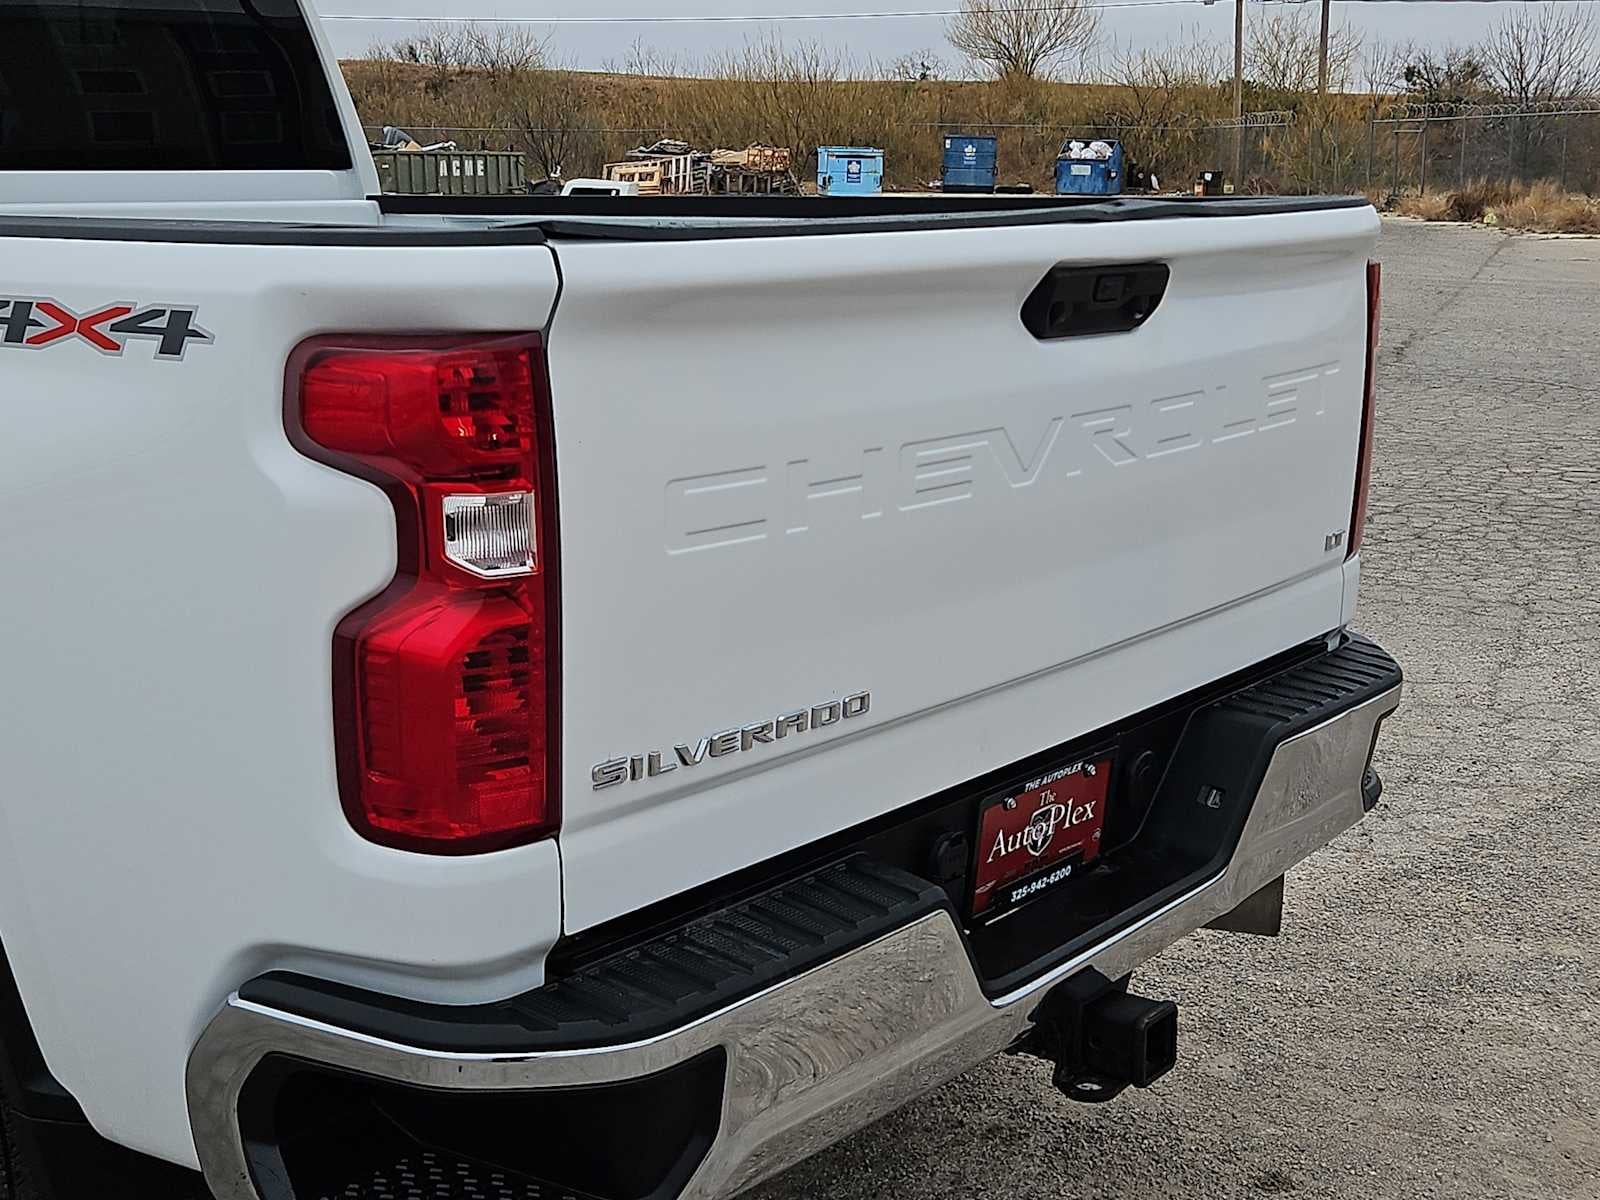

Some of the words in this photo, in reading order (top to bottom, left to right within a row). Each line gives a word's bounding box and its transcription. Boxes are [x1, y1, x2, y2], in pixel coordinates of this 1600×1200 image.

[439, 159, 485, 177] ACME
[665, 361, 1341, 556] CHEVROLET
[1324, 529, 1346, 551] LT
[591, 689, 871, 791] SILVERADO
[1024, 779, 1041, 793] THE
[1041, 761, 1084, 785] AUTOPLEX
[1039, 789, 1057, 807] The
[1010, 864, 1072, 903] 325-942-6200
